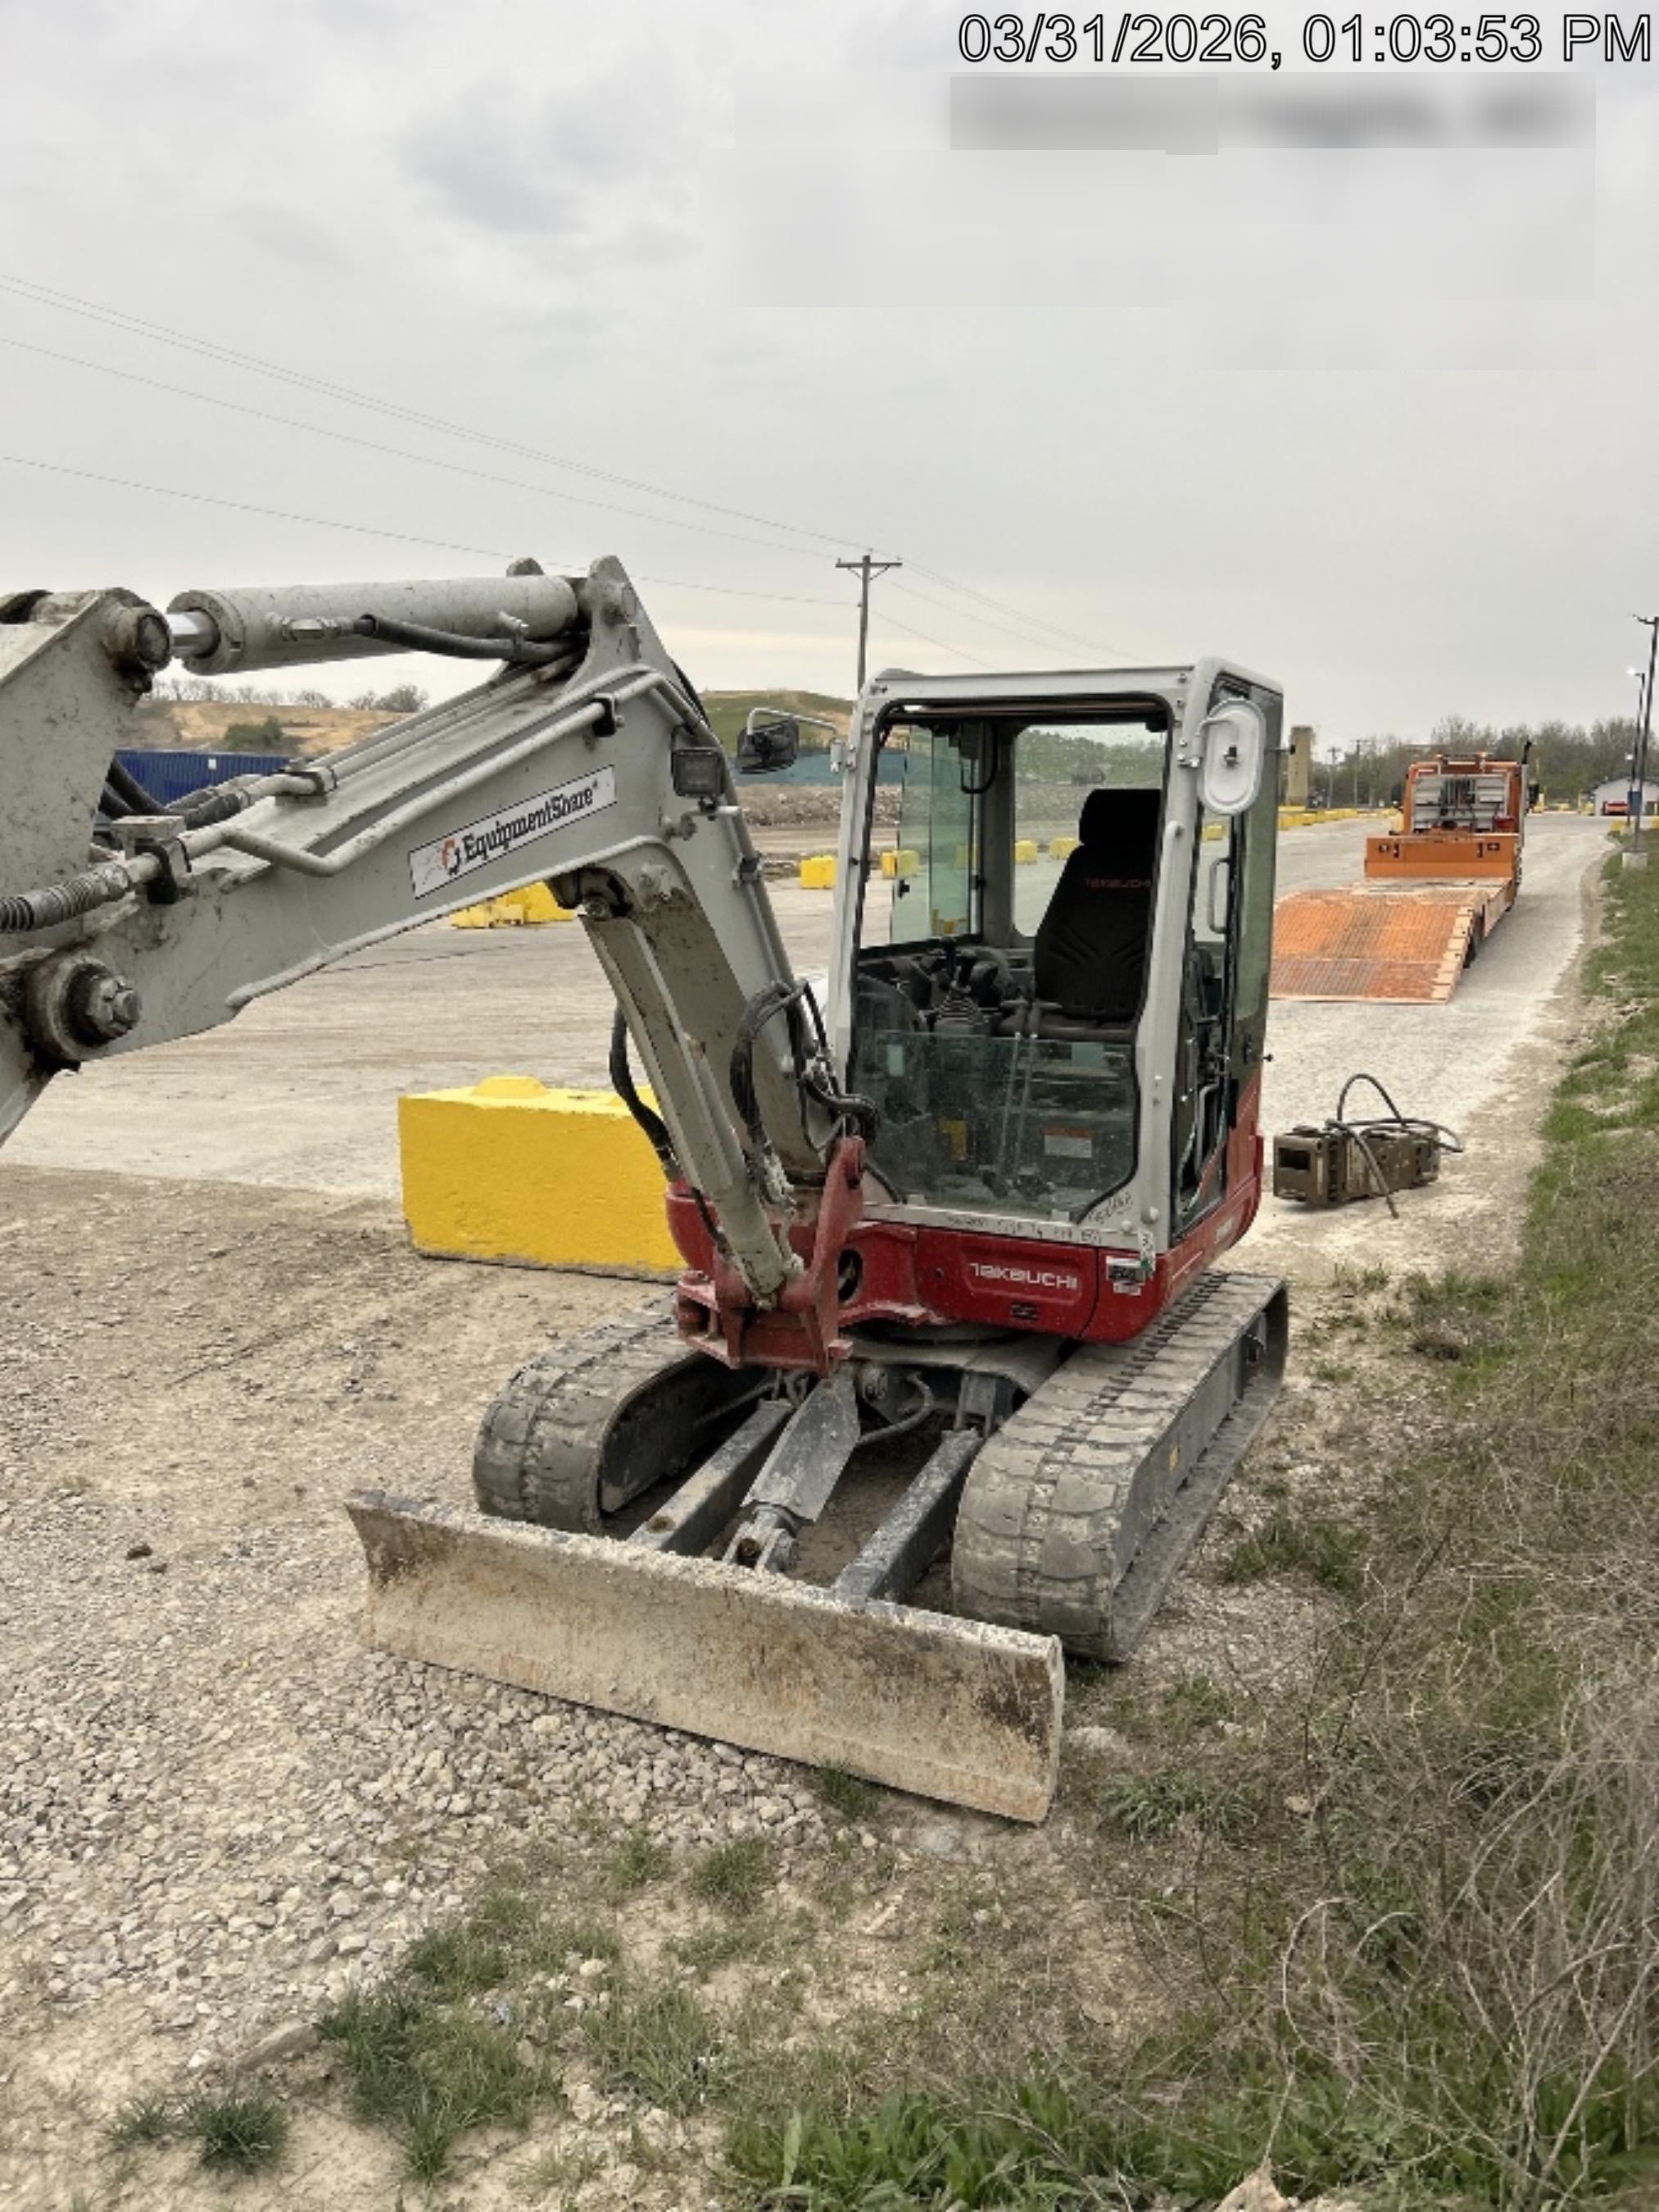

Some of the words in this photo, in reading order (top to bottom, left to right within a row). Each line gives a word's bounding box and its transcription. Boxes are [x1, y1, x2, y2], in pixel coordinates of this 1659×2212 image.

[463, 787, 594, 860] EquipmentShare
[1085, 878, 1150, 888] TAKEUCH
[970, 1263, 1078, 1290] TAKEUCHI
